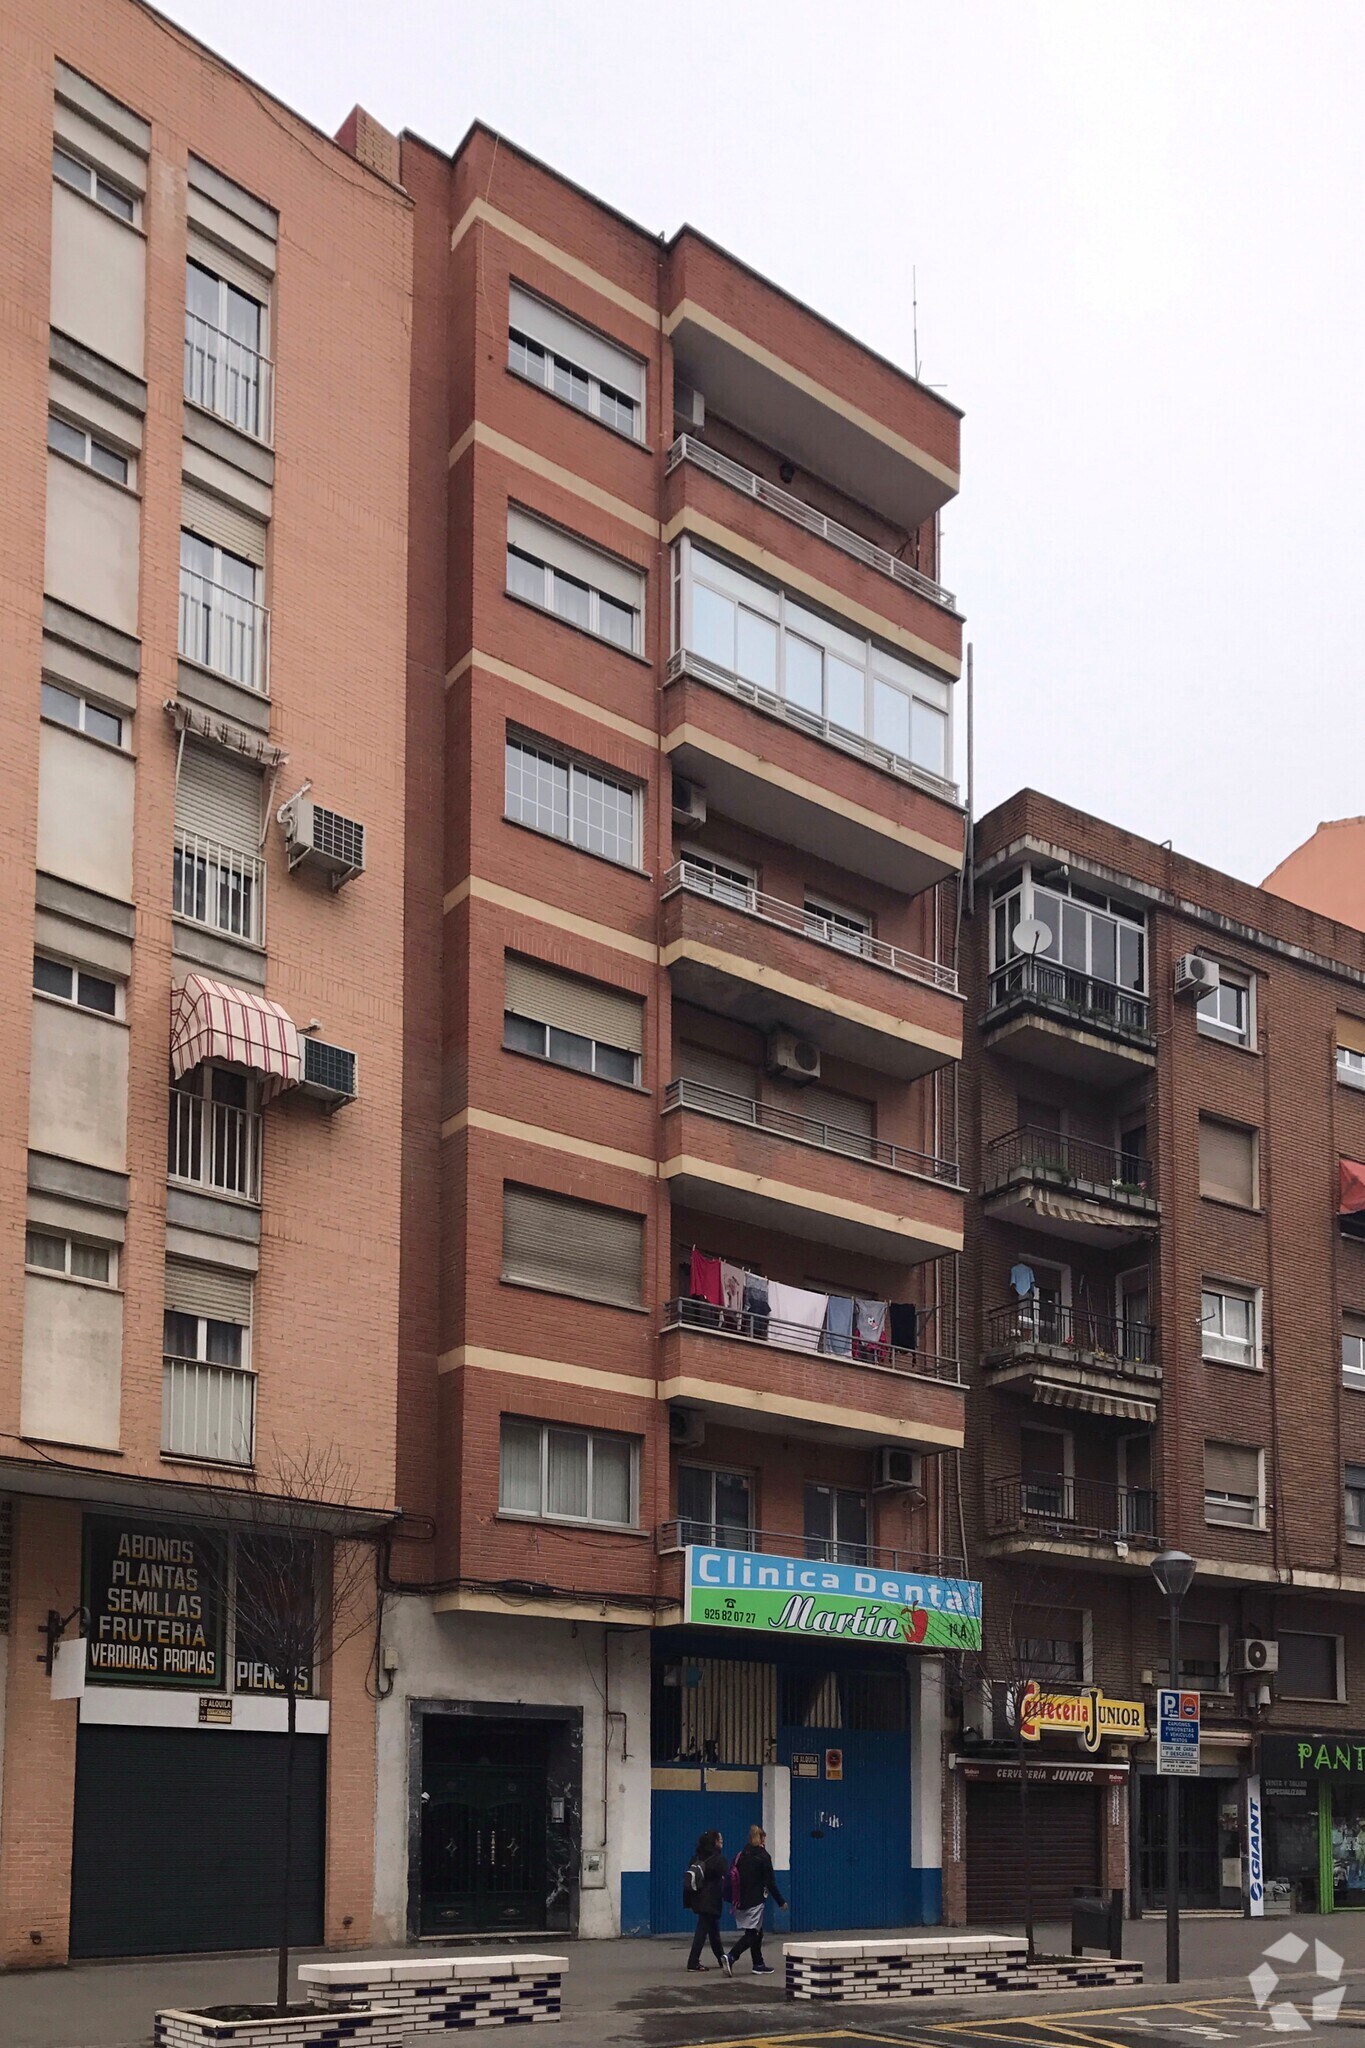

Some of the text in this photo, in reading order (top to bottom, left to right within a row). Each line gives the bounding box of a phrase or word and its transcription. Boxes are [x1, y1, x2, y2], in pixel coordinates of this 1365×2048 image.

[117, 1533, 194, 1564] ABONOS
[112, 1560, 198, 1592] PLANTAS
[699, 1553, 976, 1613] Clinica Dental
[107, 1587, 202, 1619] SEMILLAS
[704, 1608, 756, 1624] 925 82 07 27
[768, 1594, 902, 1640] Martín
[91, 1643, 215, 1675] VERDURAS PROPIAS
[200, 1699, 232, 1709] SE ALQUILA
[1083, 1690, 1140, 1747] JUNIOR
[1164, 1695, 1176, 1715] P
[793, 1755, 799, 1763] SE
[997, 1768, 1095, 1782] CERVEERÍA JUNIOR
[1249, 1797, 1261, 1880] GIANT
